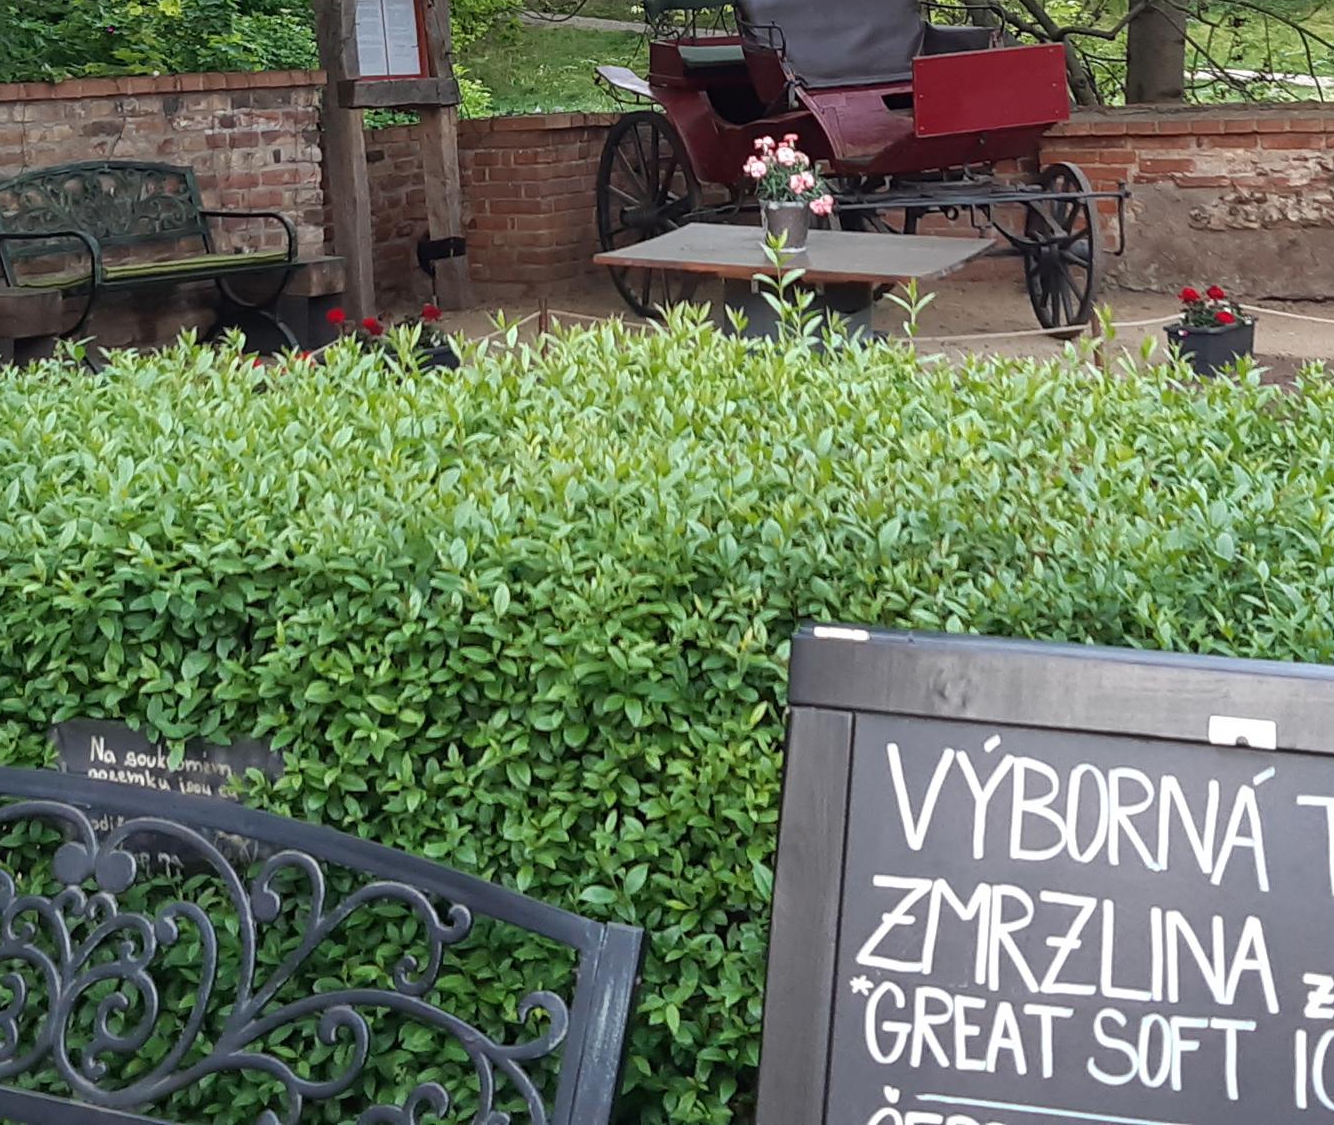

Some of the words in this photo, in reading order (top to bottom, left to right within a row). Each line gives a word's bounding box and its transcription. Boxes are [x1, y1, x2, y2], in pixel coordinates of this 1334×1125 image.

[90, 735, 116, 764] Na
[124, 744, 233, 779] soukomém
[886, 736, 1276, 892] VÝBORNÁ
[855, 875, 1280, 1015] ZMRZLINA
[1087, 1008, 1257, 1101] SOFT
